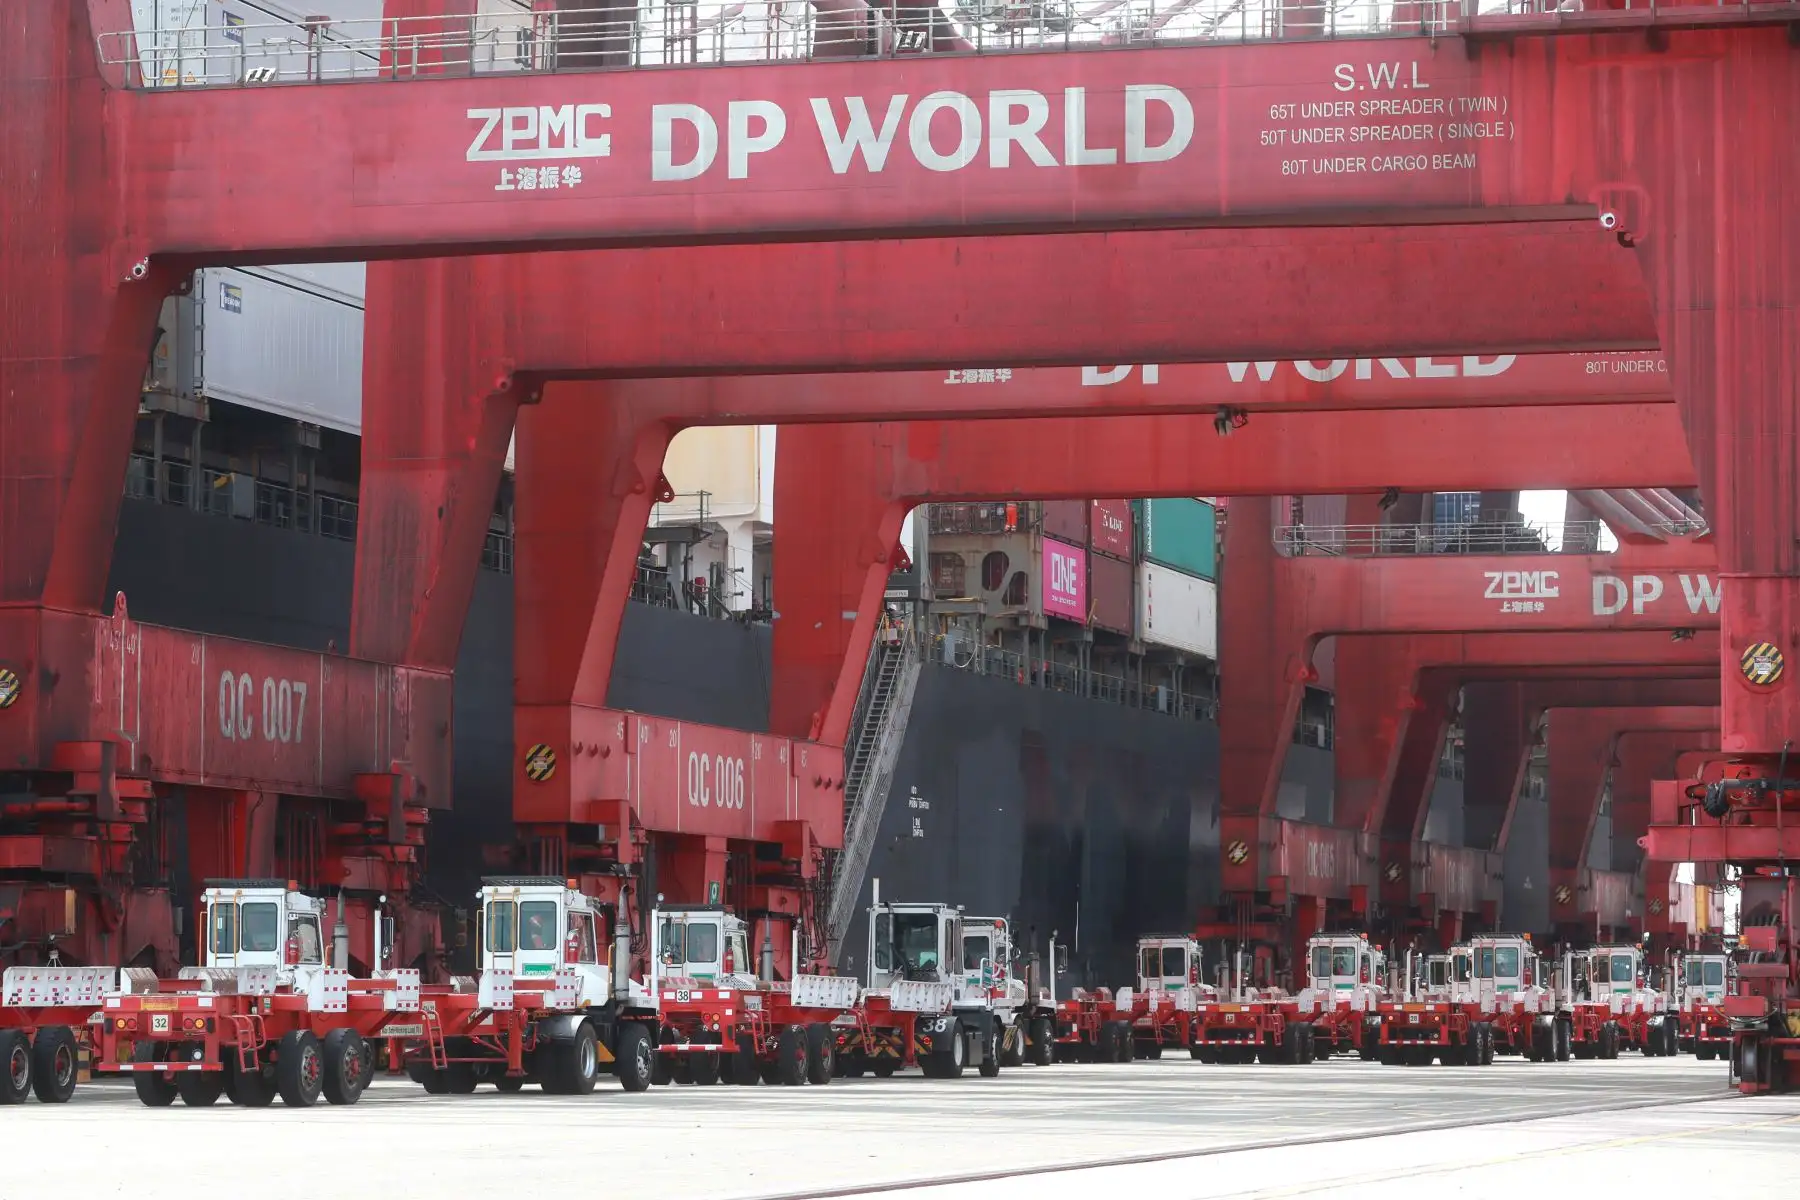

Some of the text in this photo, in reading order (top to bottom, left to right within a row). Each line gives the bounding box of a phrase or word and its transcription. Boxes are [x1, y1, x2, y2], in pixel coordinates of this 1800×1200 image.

[1334, 61, 1430, 92] S.W.L
[1269, 103, 1297, 120] 65T
[1301, 101, 1356, 118] UNDER
[1359, 98, 1444, 117] SPREADER
[466, 103, 612, 162] ZPMC
[652, 83, 1195, 182] DP WORLD
[1260, 129, 1287, 146] 50T
[1291, 127, 1346, 143] UNDER
[1349, 124, 1434, 142] SPREADER
[494, 165, 582, 191] 上海振华
[1281, 153, 1477, 176] 80T UNDER CARGO BEAM
[1585, 361, 1609, 374] 80T
[1611, 359, 1655, 373] UNDER
[1051, 552, 1077, 596] ONE
[1484, 570, 1560, 599] ZPMC
[1592, 574, 1664, 616] DP
[219, 669, 307, 744] QC 007
[688, 751, 744, 810] QC 006
[678, 990, 689, 1001] 38
[154, 1018, 167, 1029] 32
[923, 1019, 948, 1033] 38
